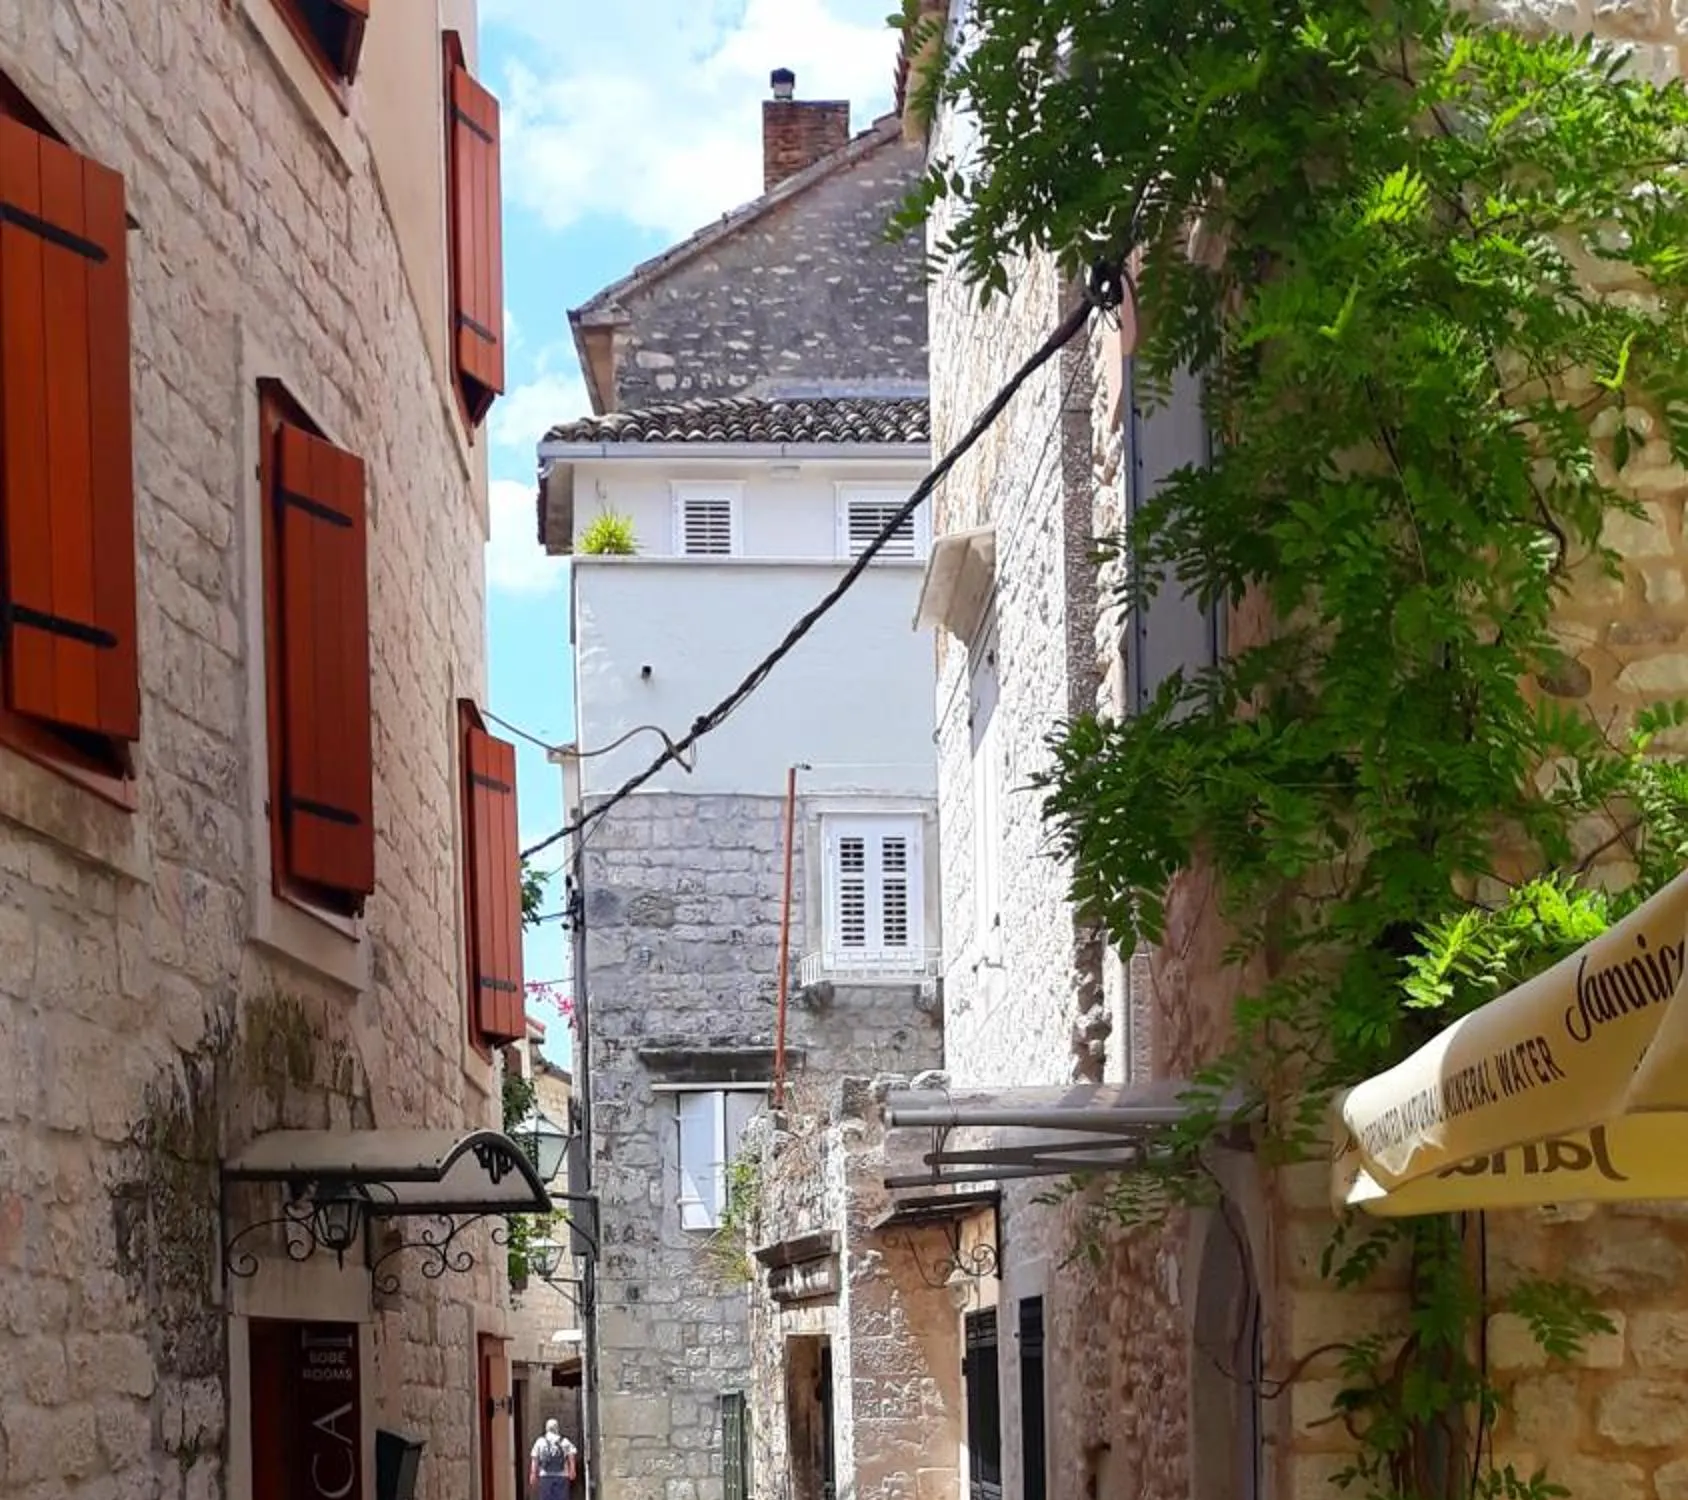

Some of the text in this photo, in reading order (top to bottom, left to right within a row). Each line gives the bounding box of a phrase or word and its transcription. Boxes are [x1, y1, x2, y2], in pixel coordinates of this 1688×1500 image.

[1565, 934, 1685, 1043] Jamnic
[1494, 1035, 1567, 1098] WATER
[303, 1367, 352, 1382] ROOMS
